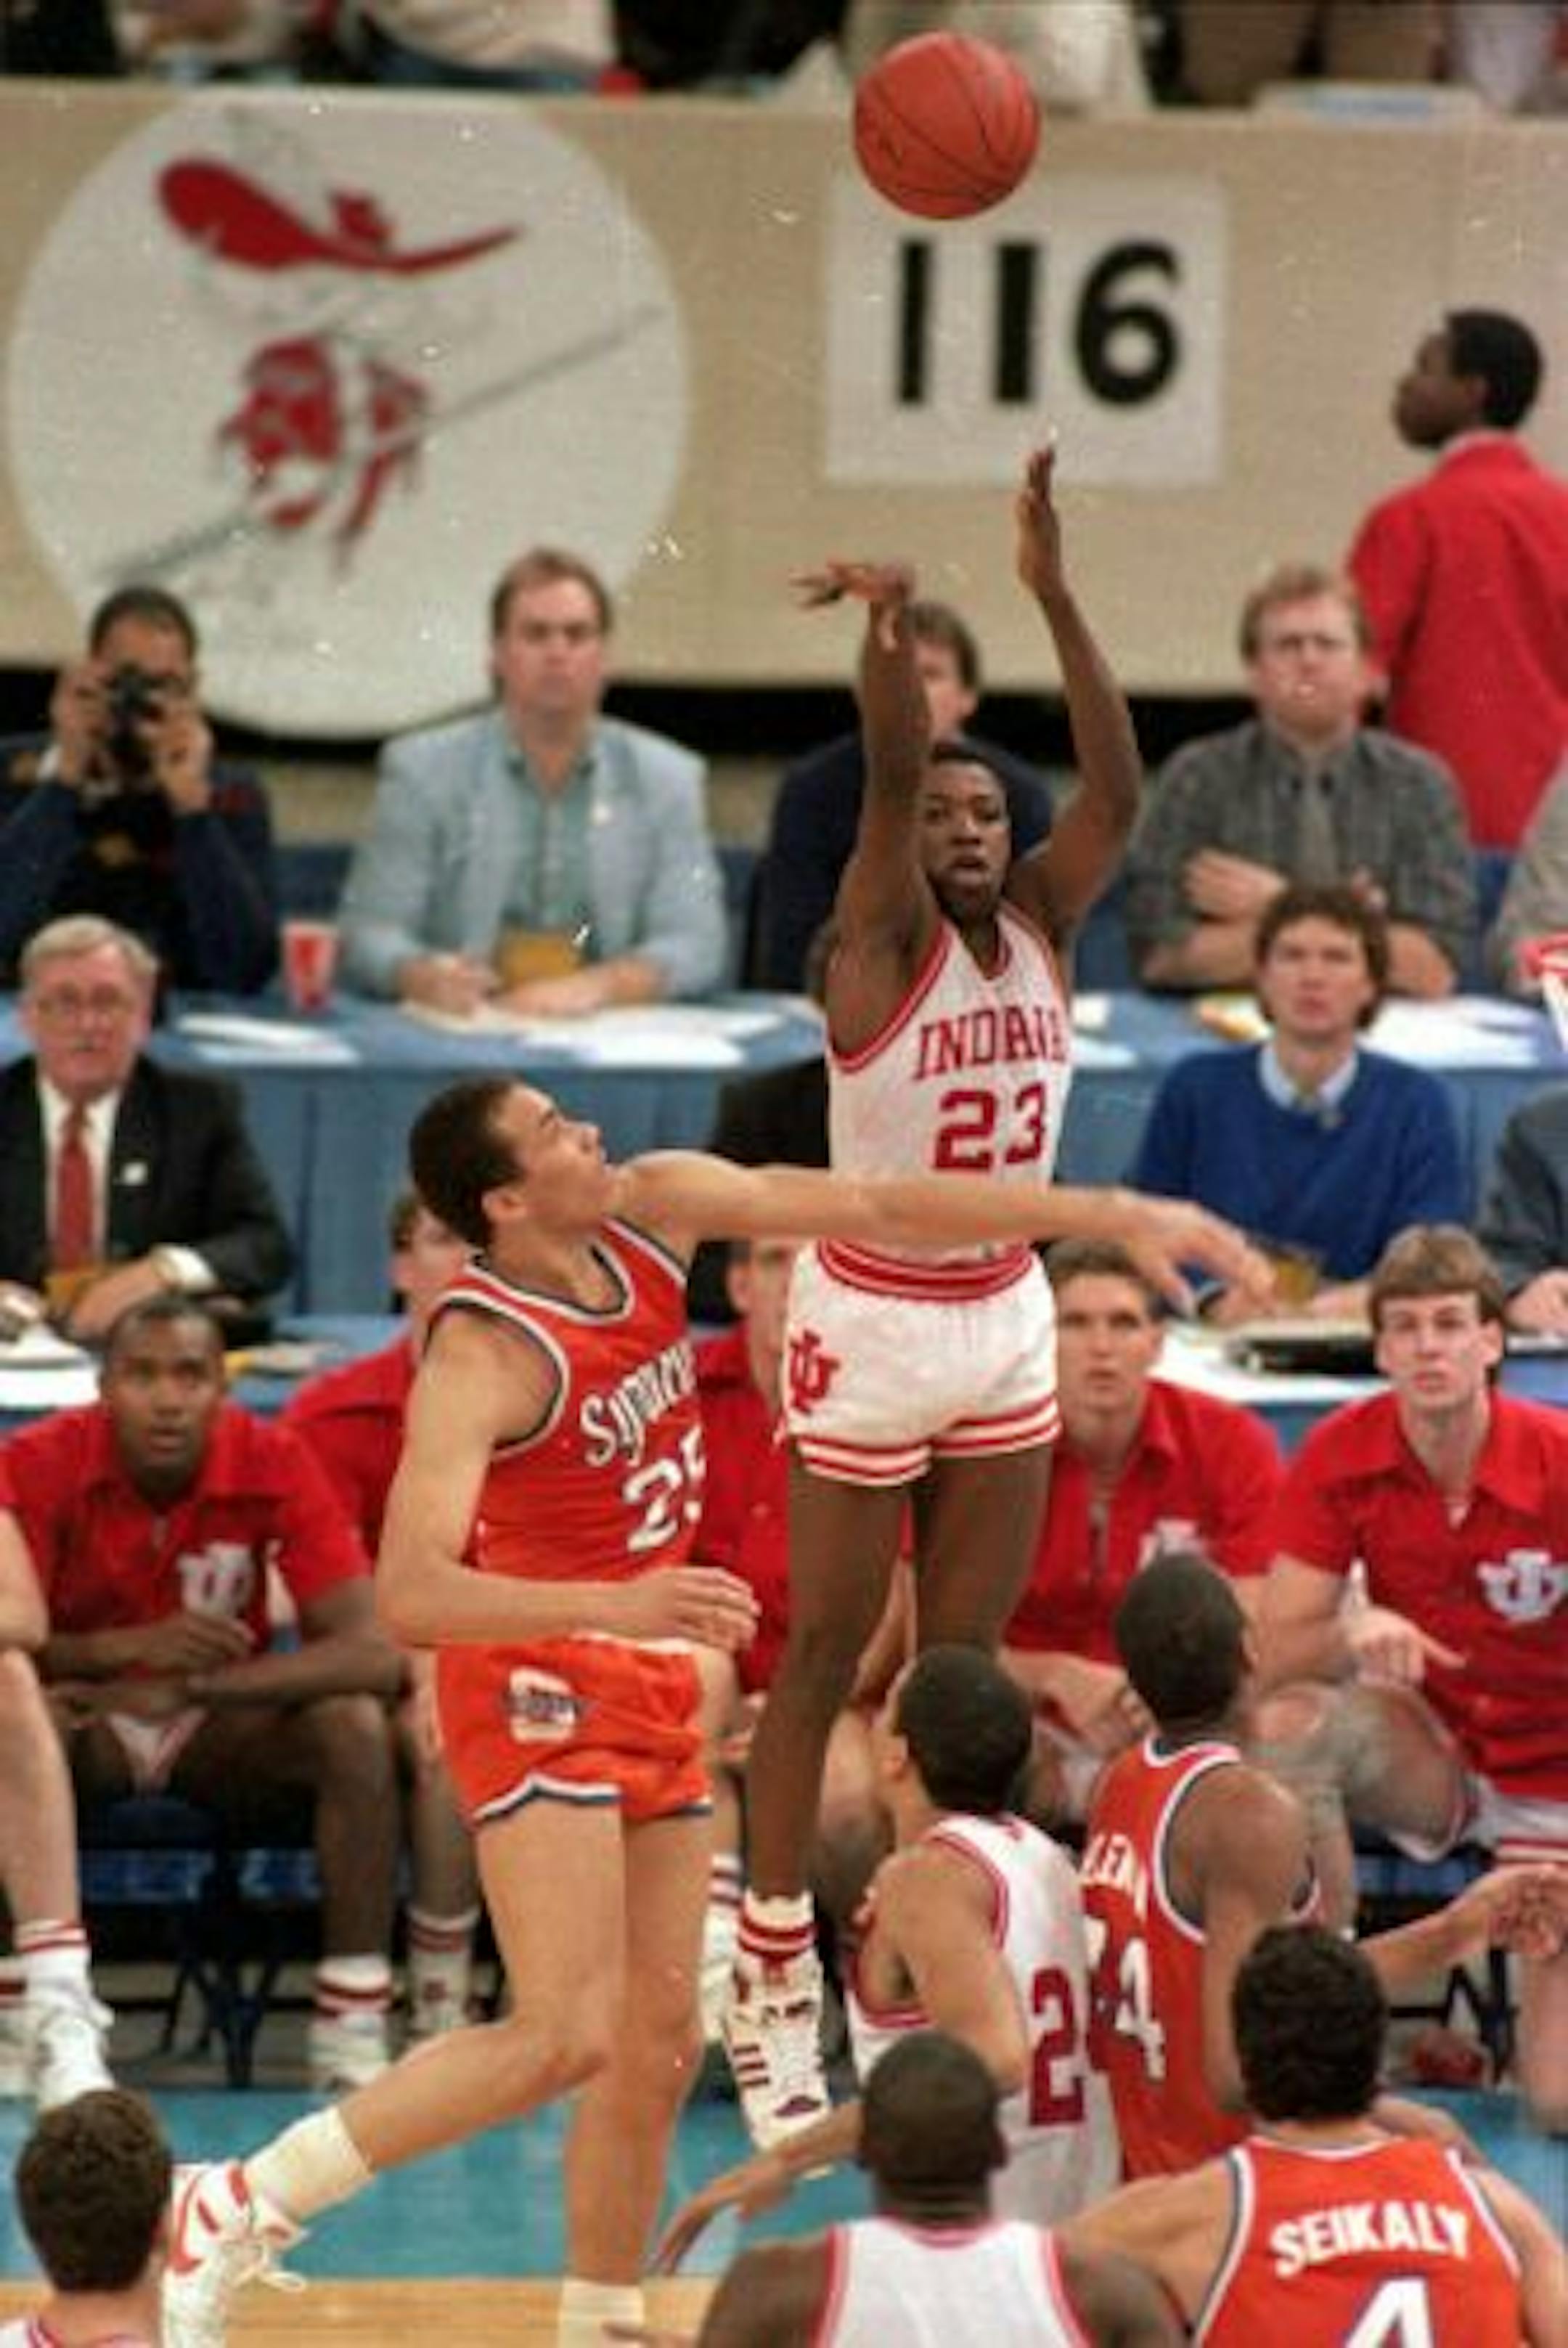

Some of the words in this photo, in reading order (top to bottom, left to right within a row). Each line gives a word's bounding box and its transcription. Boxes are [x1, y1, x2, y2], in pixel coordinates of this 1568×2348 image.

[897, 240, 1180, 407] 116
[932, 1082, 1046, 1171] 23
[1270, 2200, 1469, 2279] SEIKALY
[1344, 2276, 1434, 2348] 4
